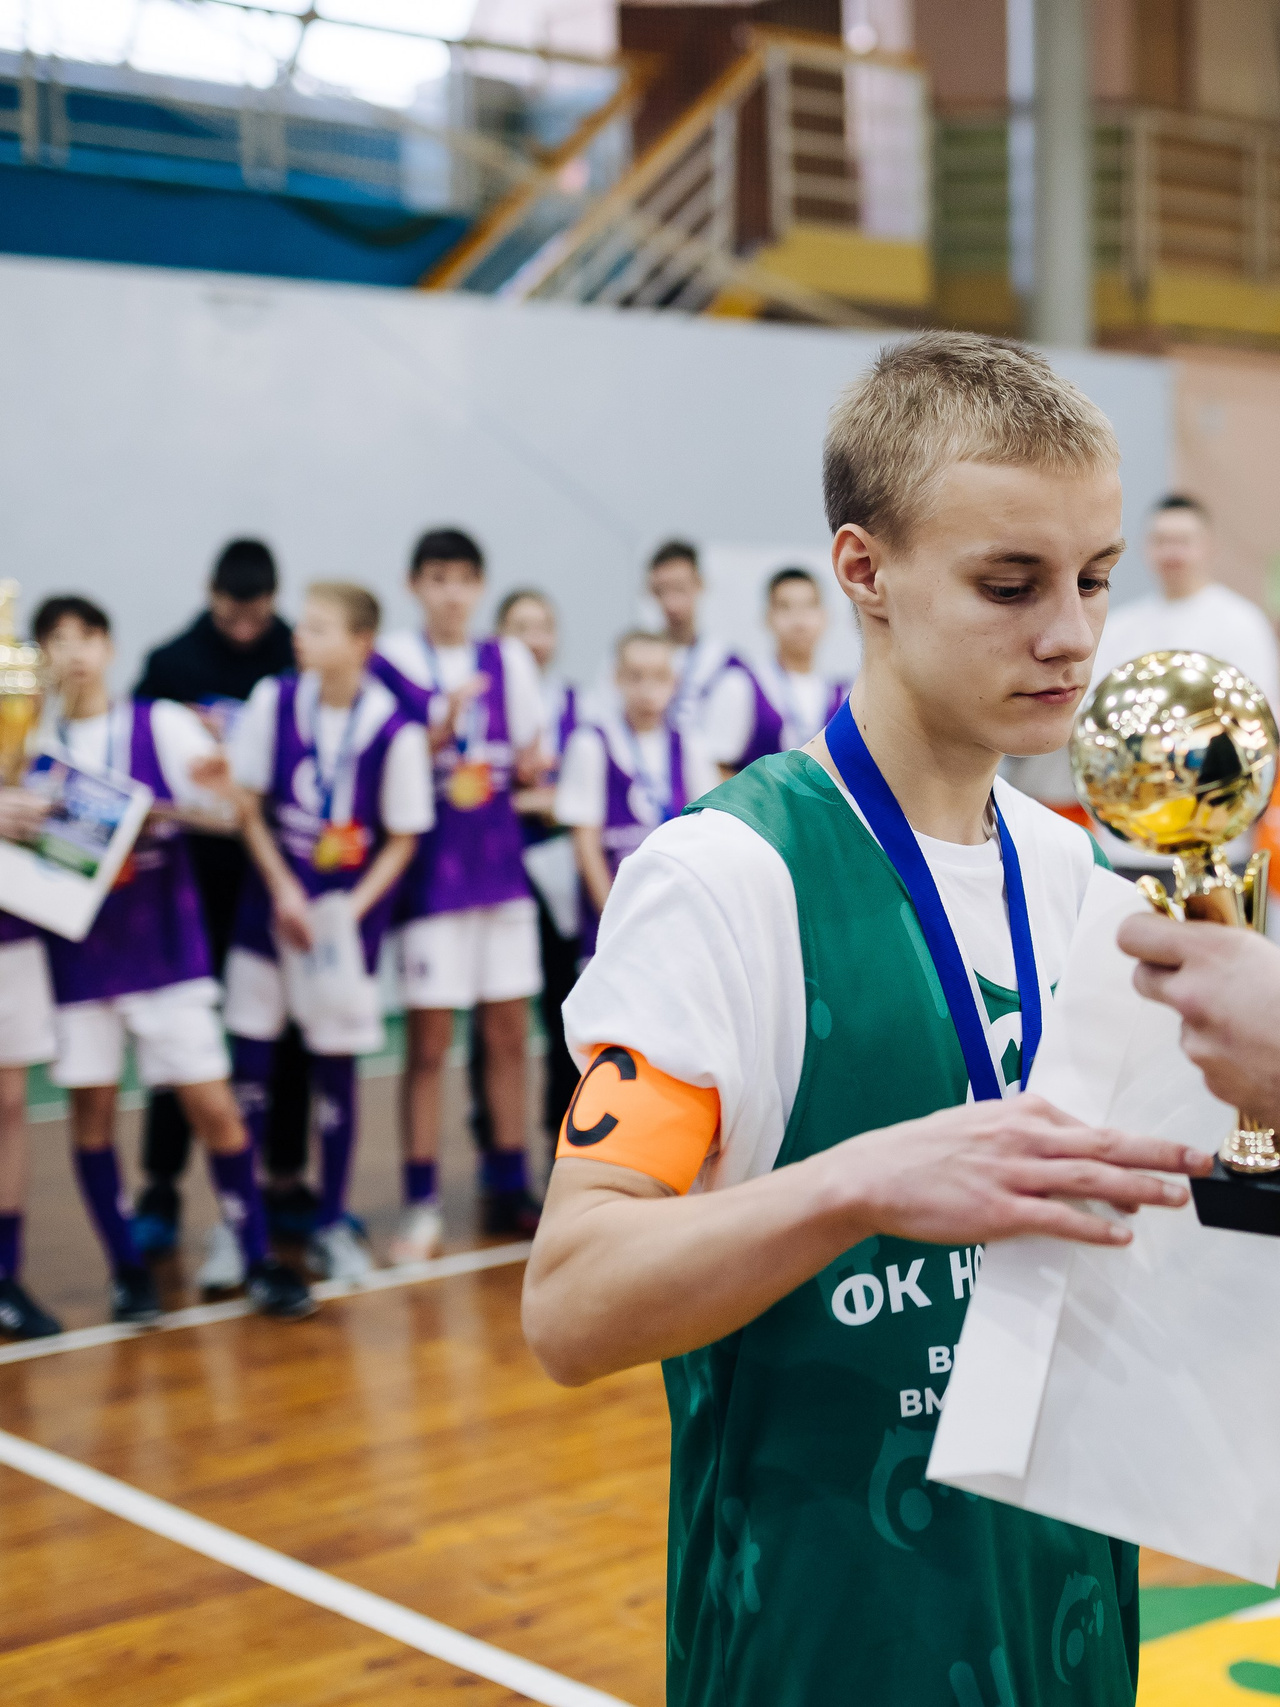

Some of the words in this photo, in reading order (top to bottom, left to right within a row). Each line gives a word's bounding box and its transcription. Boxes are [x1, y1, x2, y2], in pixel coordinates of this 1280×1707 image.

[566, 1046, 637, 1148] C
[831, 1257, 933, 1326] ФК
[928, 1344, 959, 1374] В
